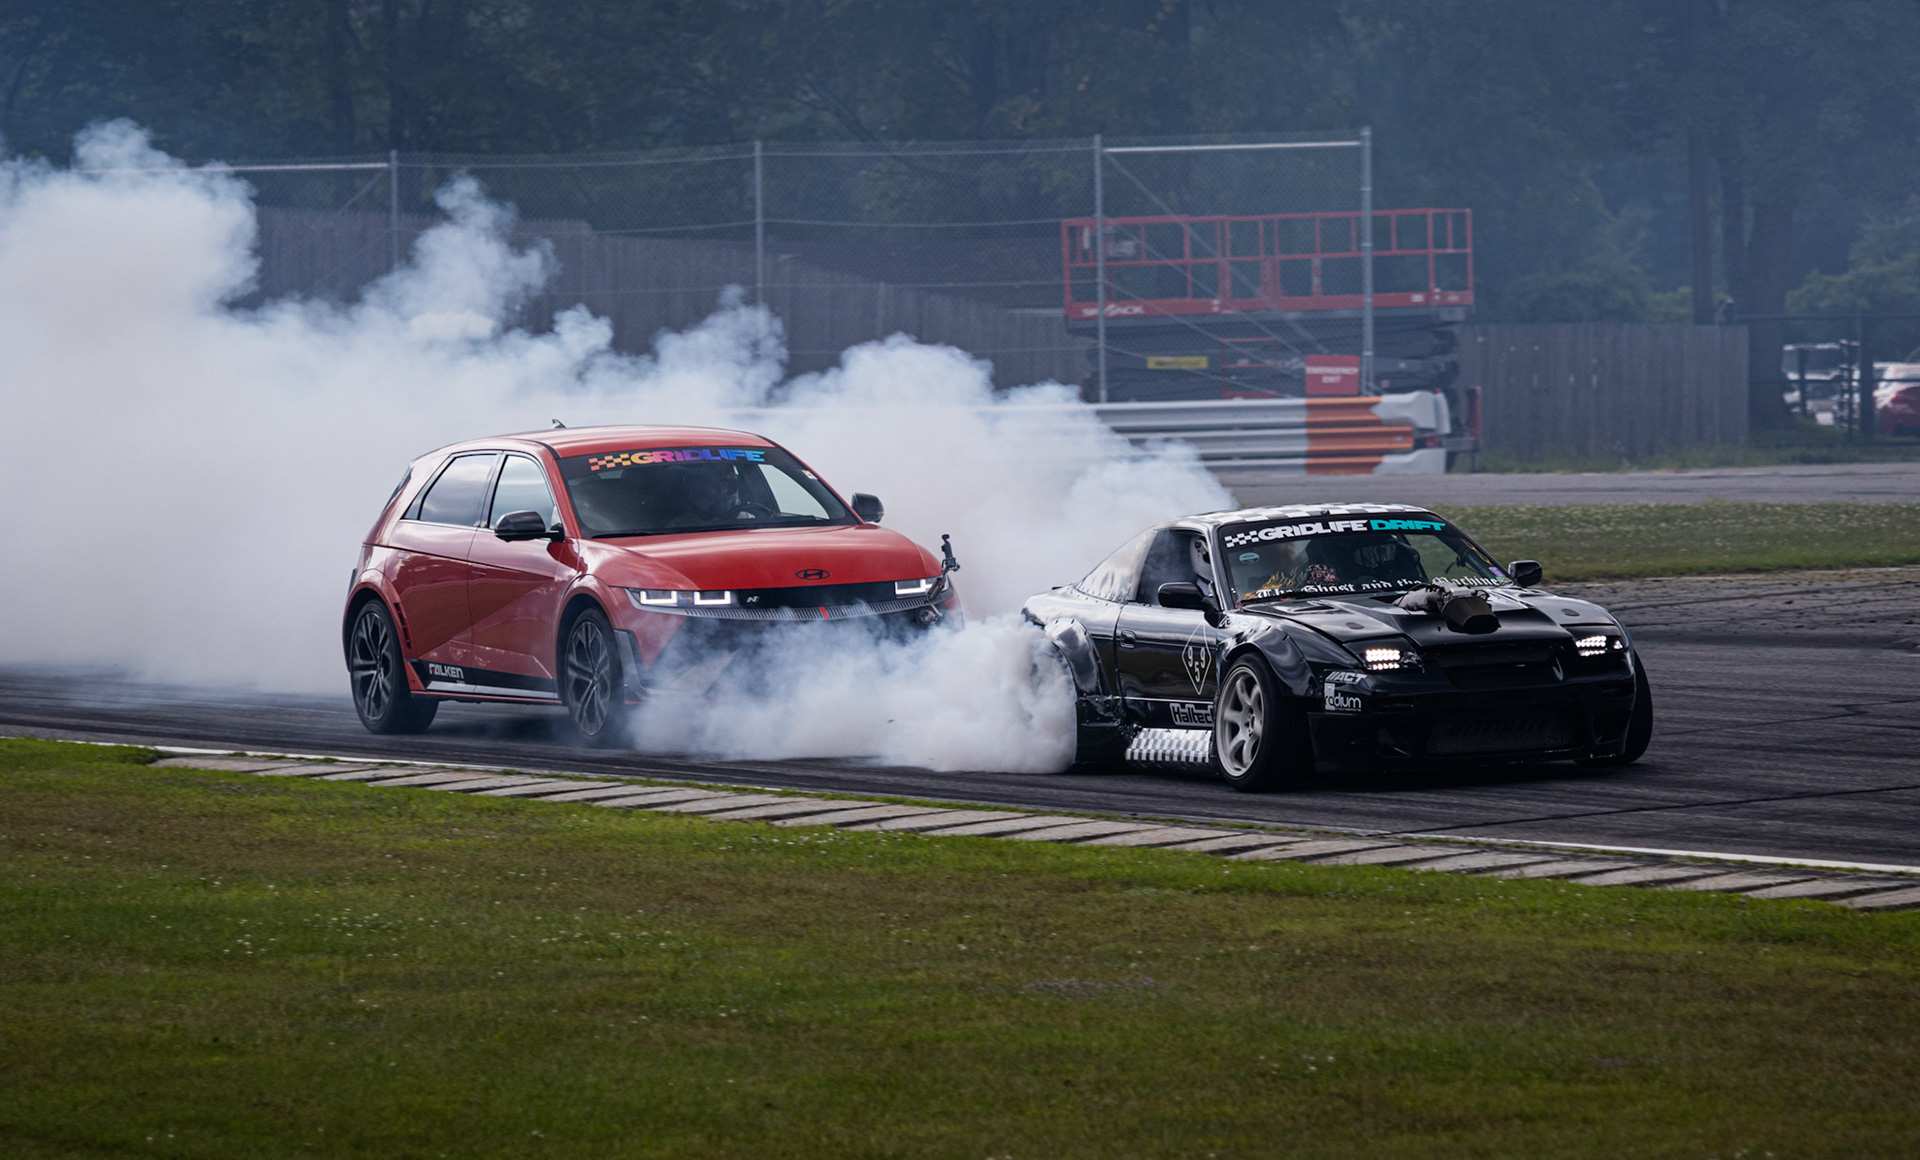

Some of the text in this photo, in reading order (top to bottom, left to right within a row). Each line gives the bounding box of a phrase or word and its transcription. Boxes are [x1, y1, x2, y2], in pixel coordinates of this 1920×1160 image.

[630, 449, 766, 465] GRIDLIFE
[1257, 518, 1447, 542] GRIDLIFE DRIFT
[428, 662, 465, 679] FALKEN
